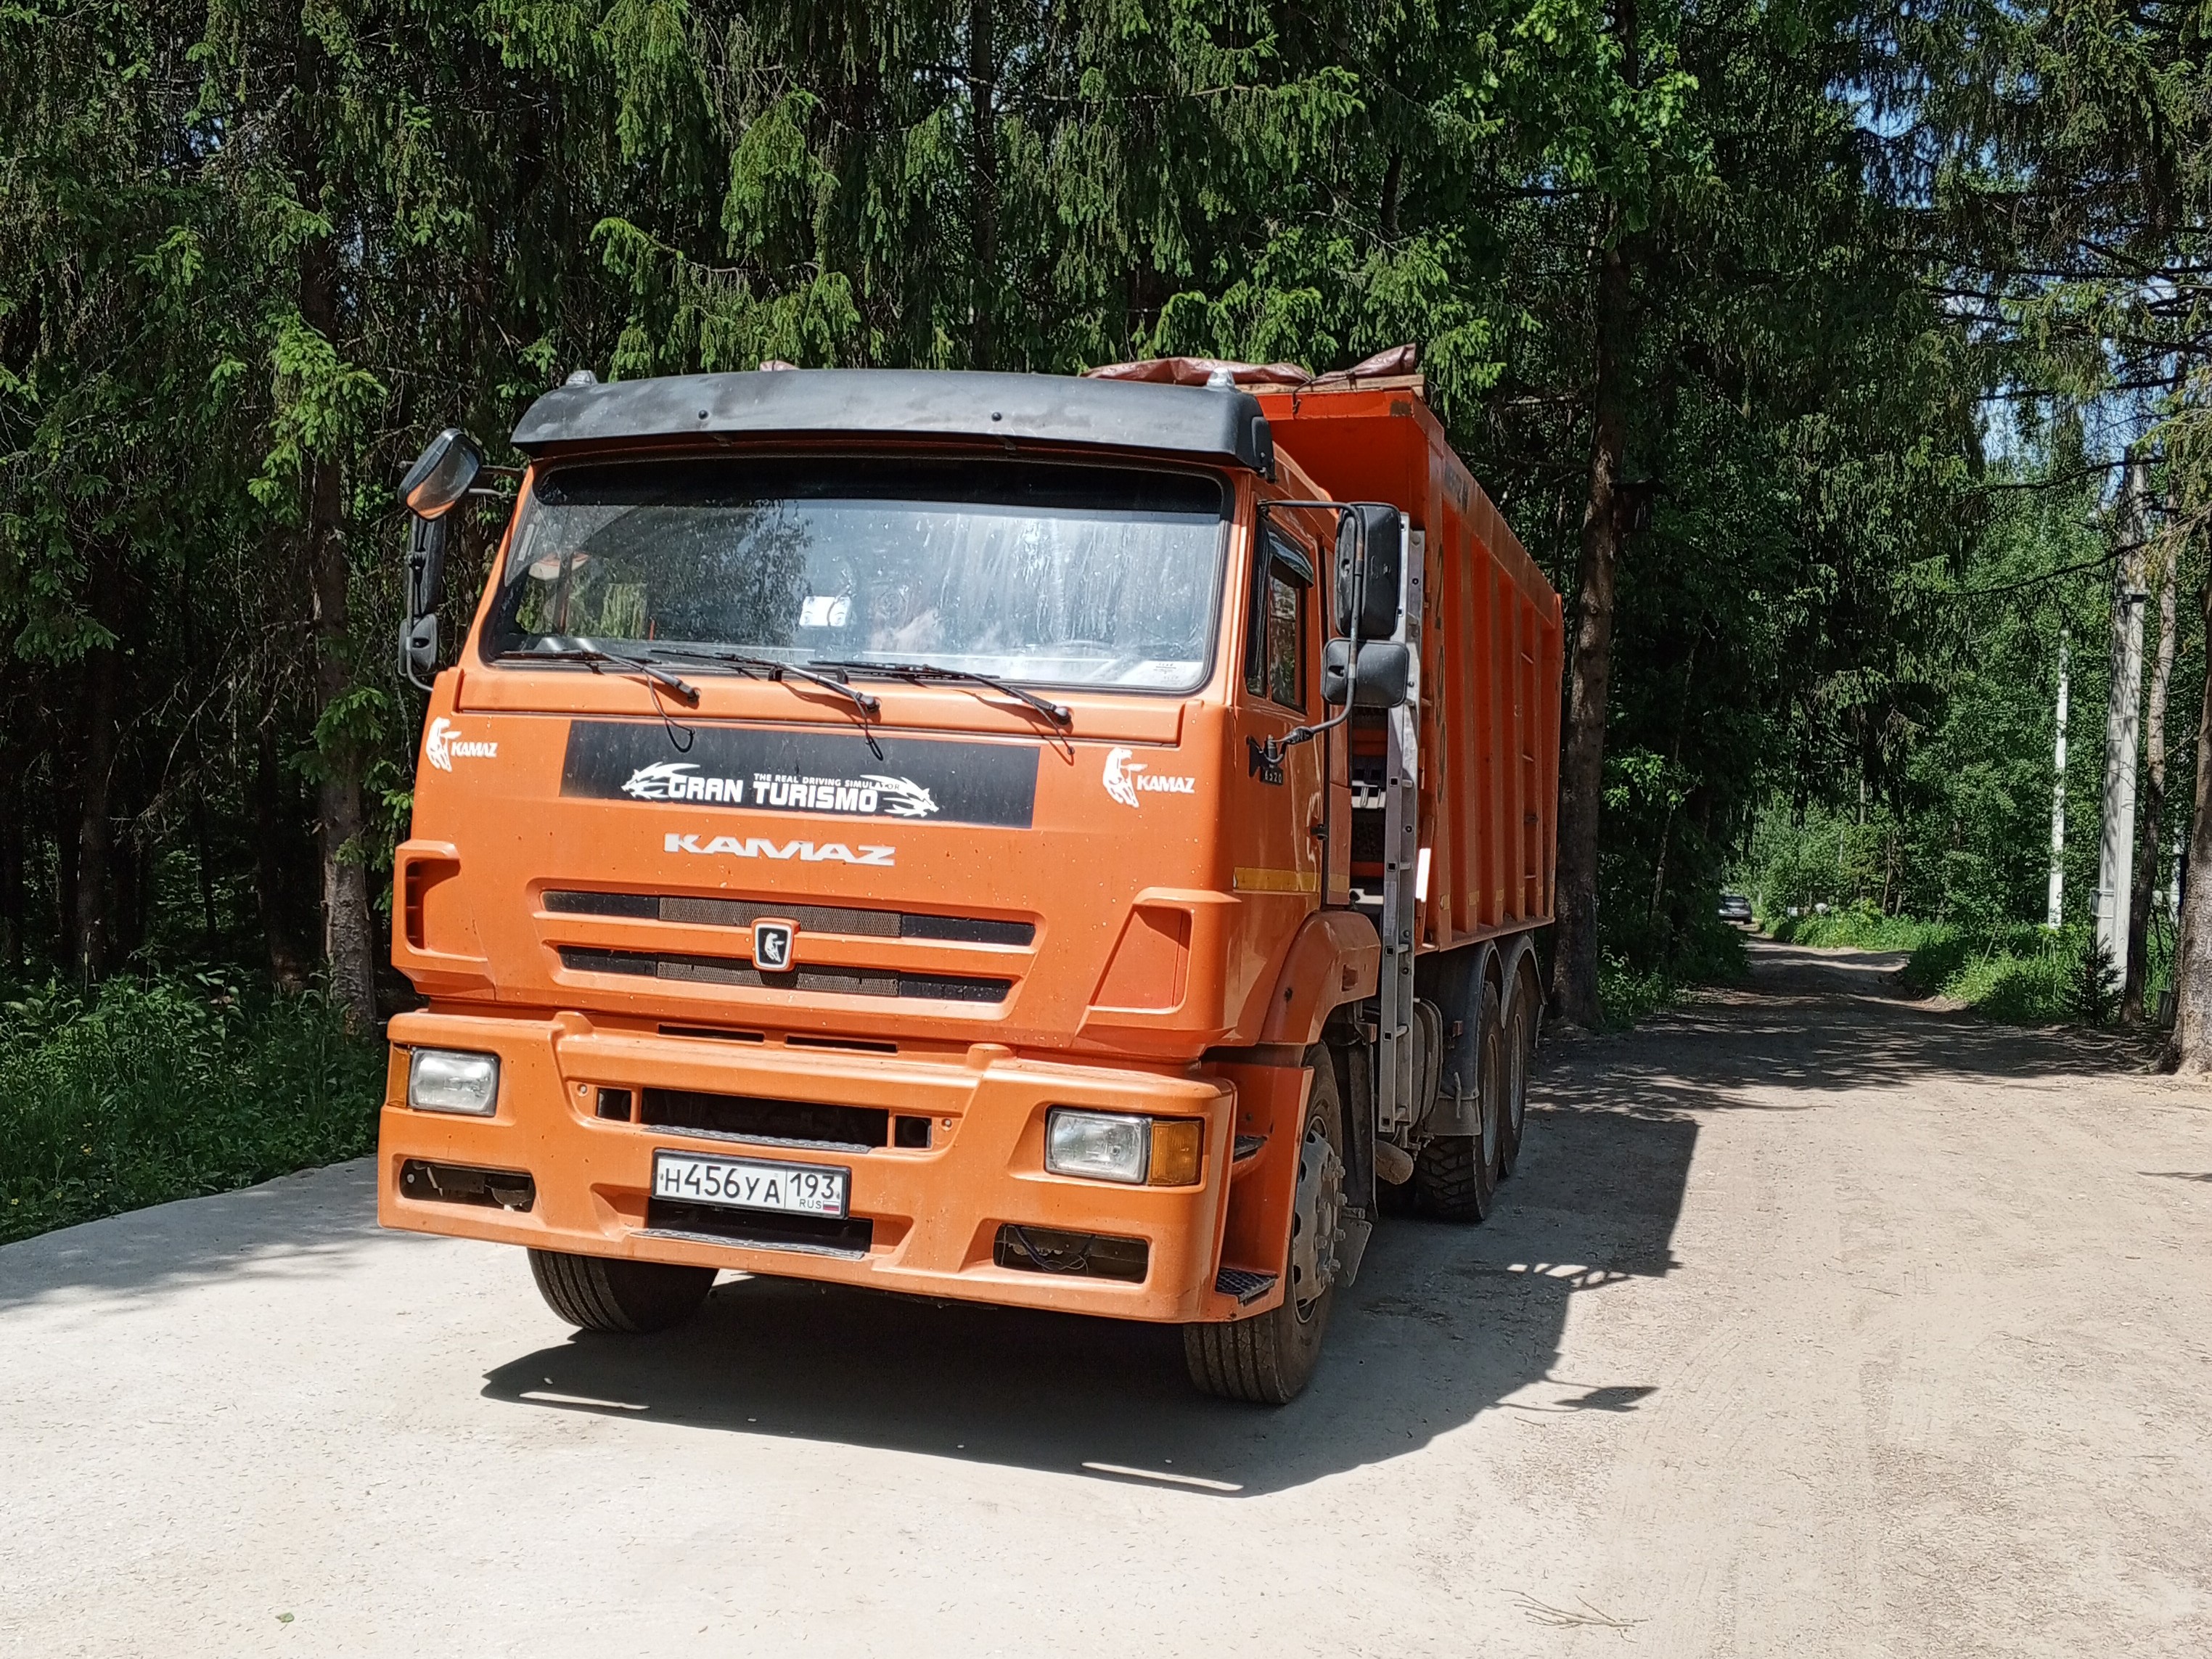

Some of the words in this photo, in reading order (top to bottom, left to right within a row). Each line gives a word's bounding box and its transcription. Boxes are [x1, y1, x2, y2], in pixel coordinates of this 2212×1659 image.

[451, 742, 499, 758] KAMAZ
[753, 773, 771, 782] THE
[775, 775, 798, 784] REAL
[803, 777, 841, 787] DRIVING
[844, 779, 900, 791] SIMULATOR
[1136, 774, 1195, 793] KAMAZ
[668, 775, 744, 803] GRAN
[753, 781, 878, 812] TURISMO
[664, 832, 896, 866] KAMAZ
[790, 1173, 835, 1200] 193
[799, 1198, 822, 1210] RUS
